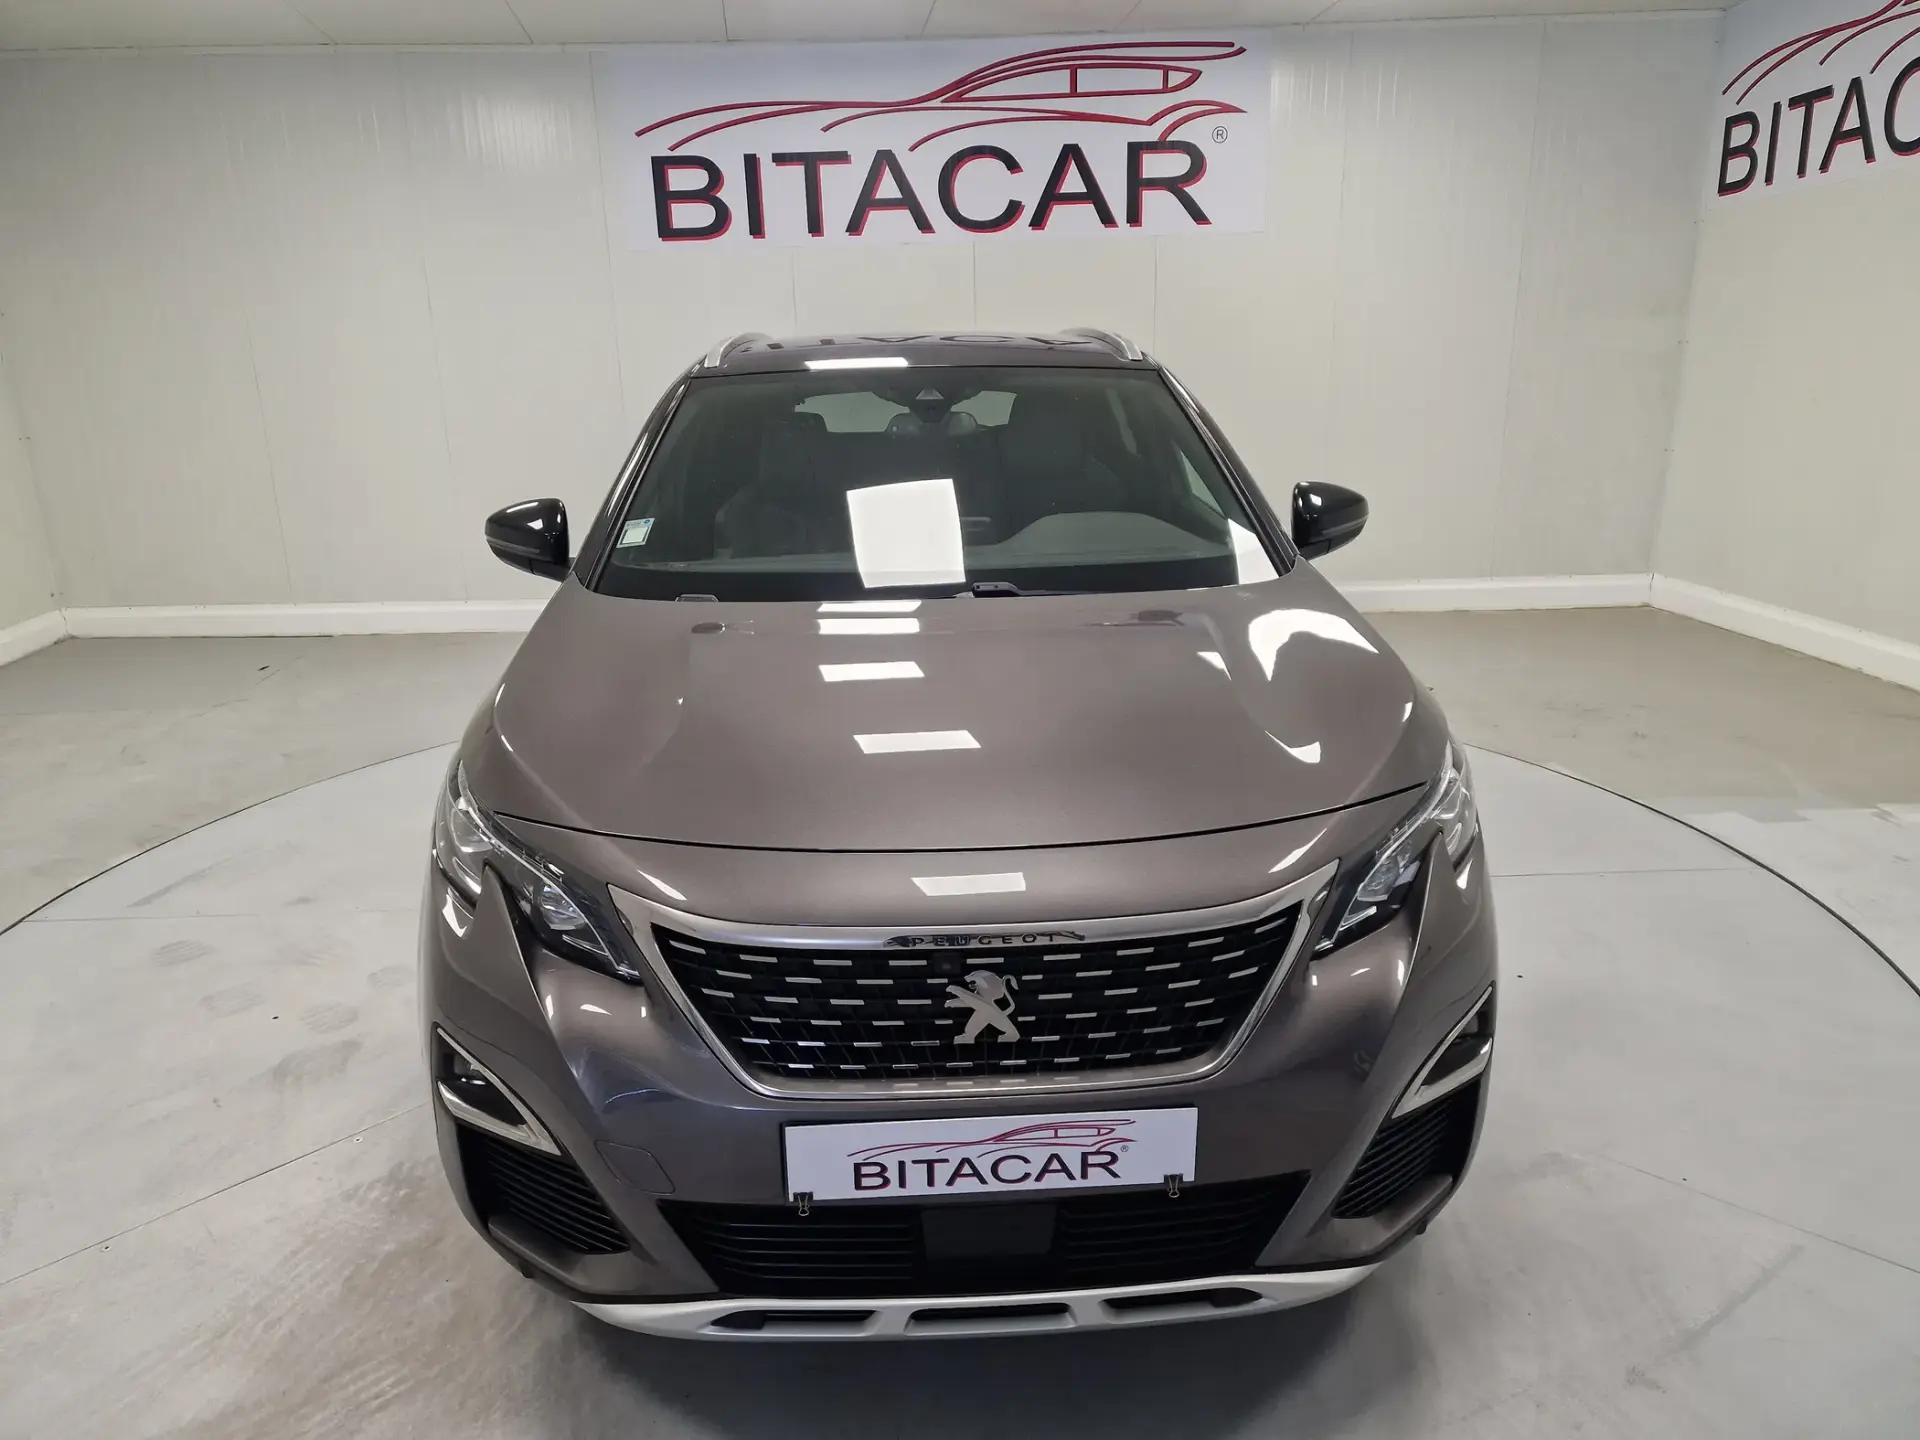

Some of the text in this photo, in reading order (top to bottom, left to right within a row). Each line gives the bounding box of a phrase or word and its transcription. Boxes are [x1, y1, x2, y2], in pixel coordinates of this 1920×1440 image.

[650, 140, 1211, 241] BITACAR
[911, 932, 1055, 947] PEUGEOT
[853, 1151, 1121, 1191] BITACAR
